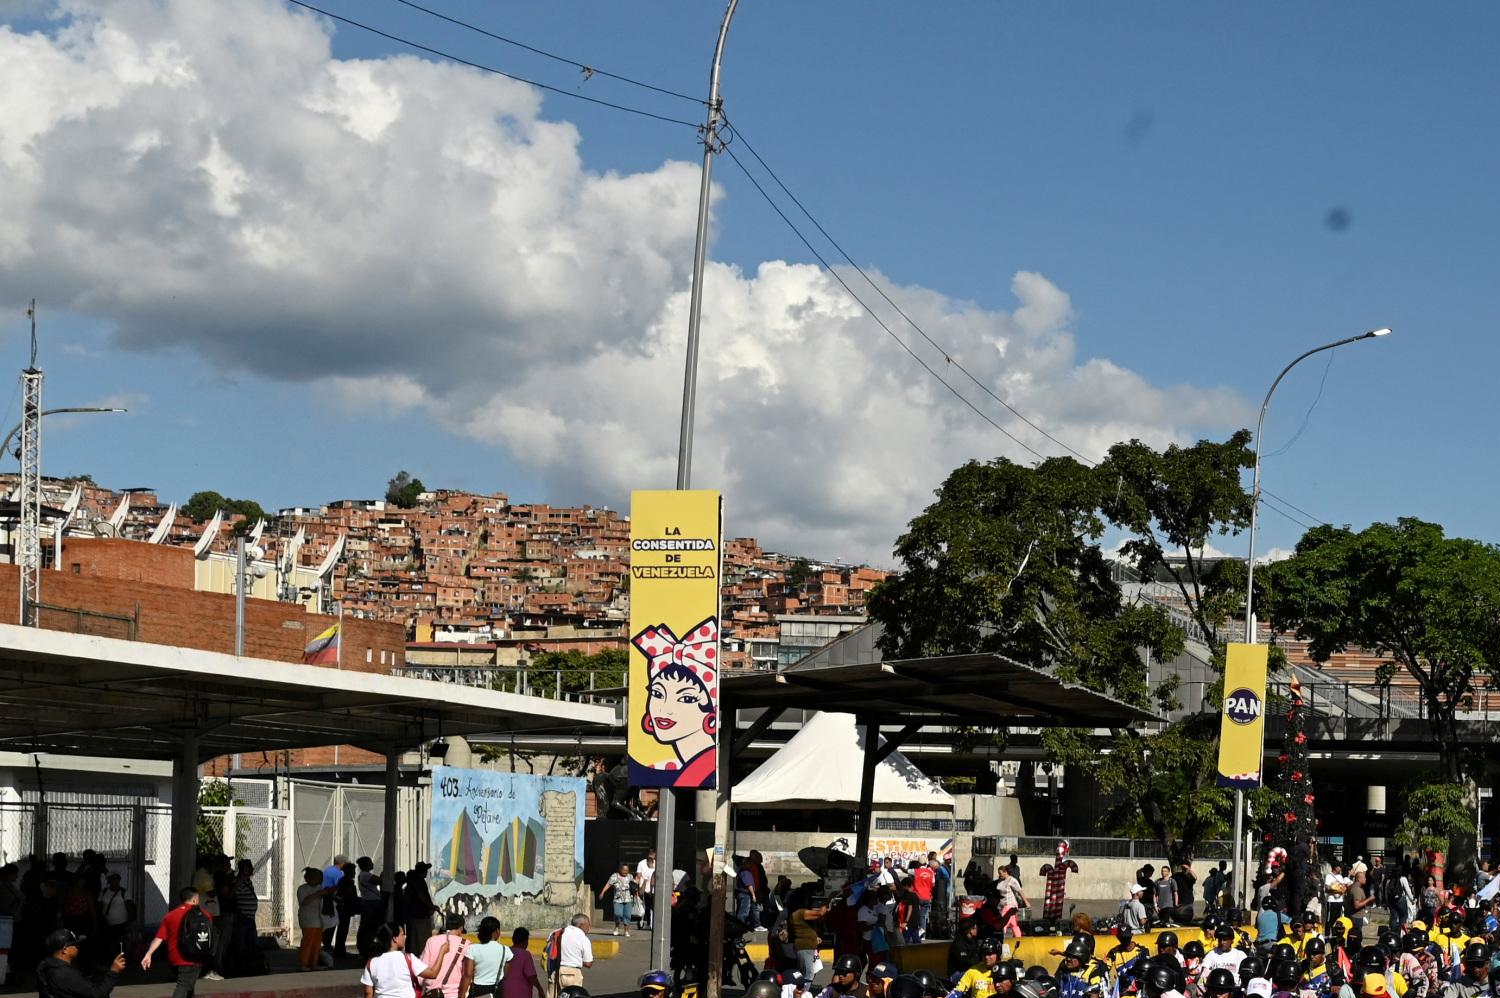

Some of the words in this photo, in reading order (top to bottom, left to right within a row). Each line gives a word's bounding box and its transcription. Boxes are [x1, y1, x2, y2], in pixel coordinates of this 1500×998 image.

[665, 527, 681, 536] LA
[632, 539, 715, 551] CONSENTIDA
[665, 554, 681, 562] DE
[632, 566, 714, 578] VENEZUELA
[508, 776, 516, 799] de
[473, 802, 502, 833] Petare
